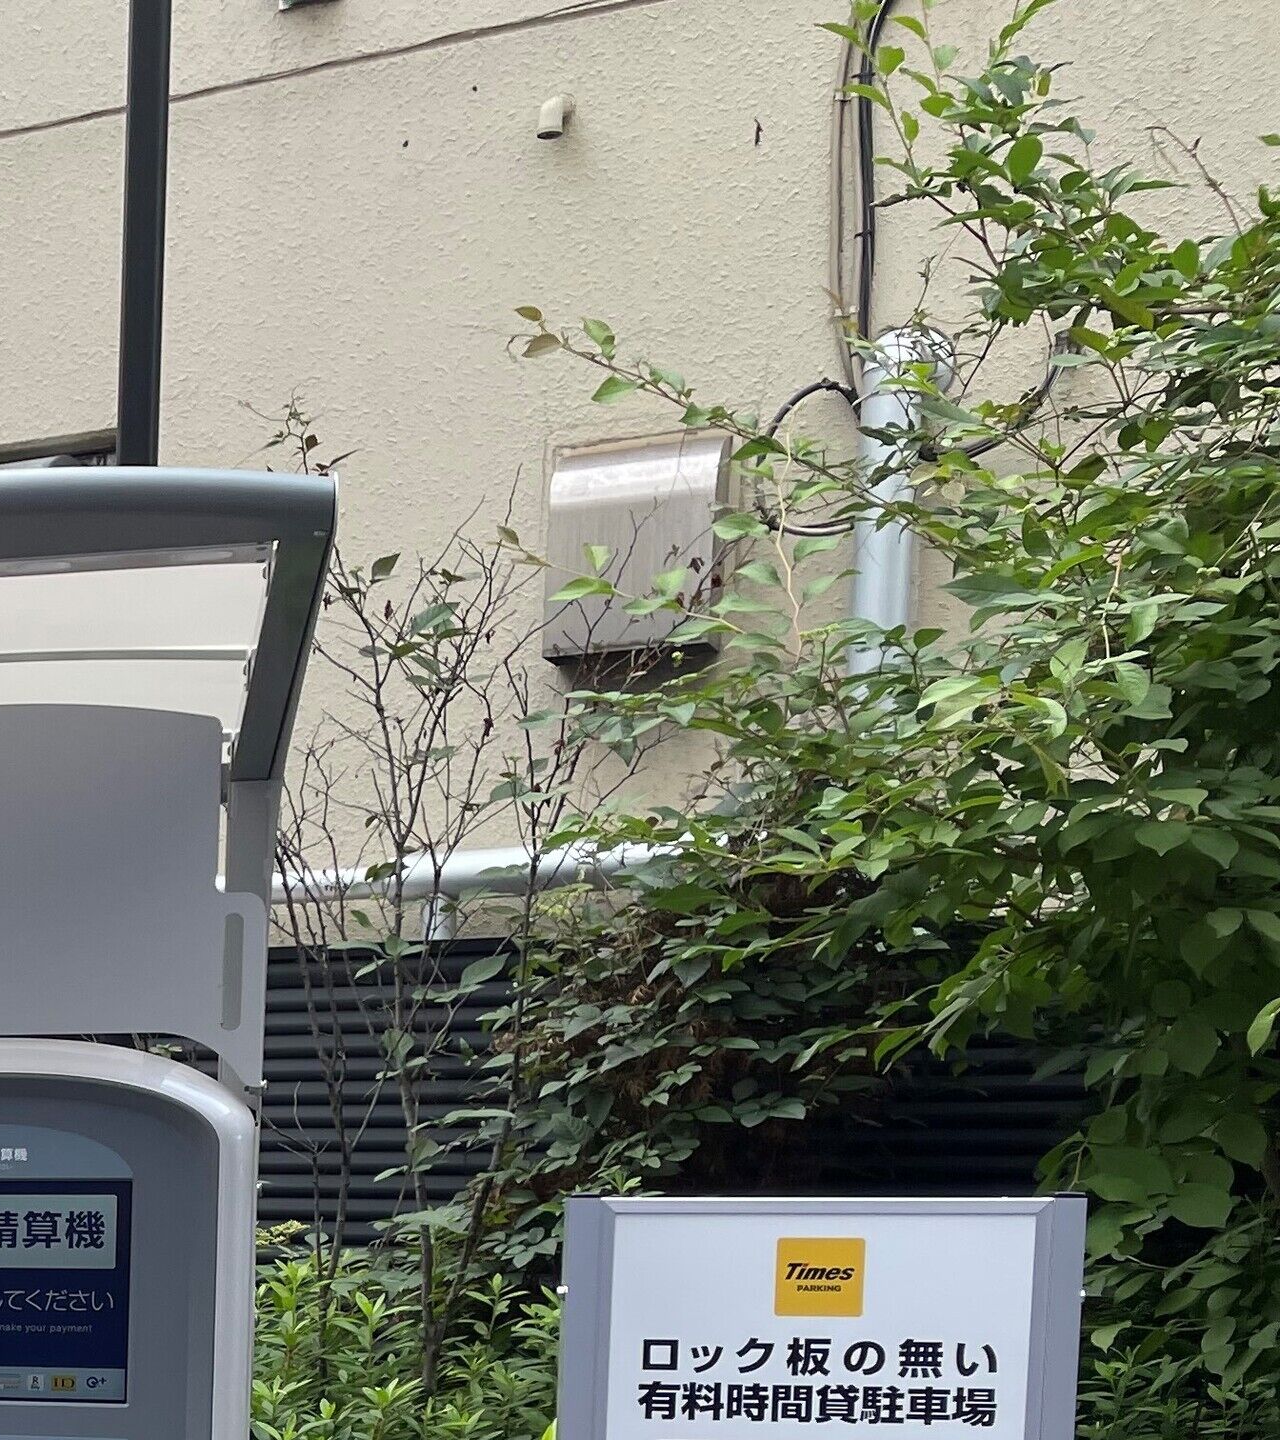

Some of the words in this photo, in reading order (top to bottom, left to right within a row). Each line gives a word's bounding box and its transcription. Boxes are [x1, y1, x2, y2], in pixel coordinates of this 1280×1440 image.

[785, 1262, 855, 1281] Times
[796, 1284, 842, 1292] PARKING
[24, 1324, 47, 1335] your
[49, 1324, 92, 1335] payment
[641, 1338, 998, 1378] ロック板の無い
[638, 1381, 997, 1426] 有料時間貸駐車場
